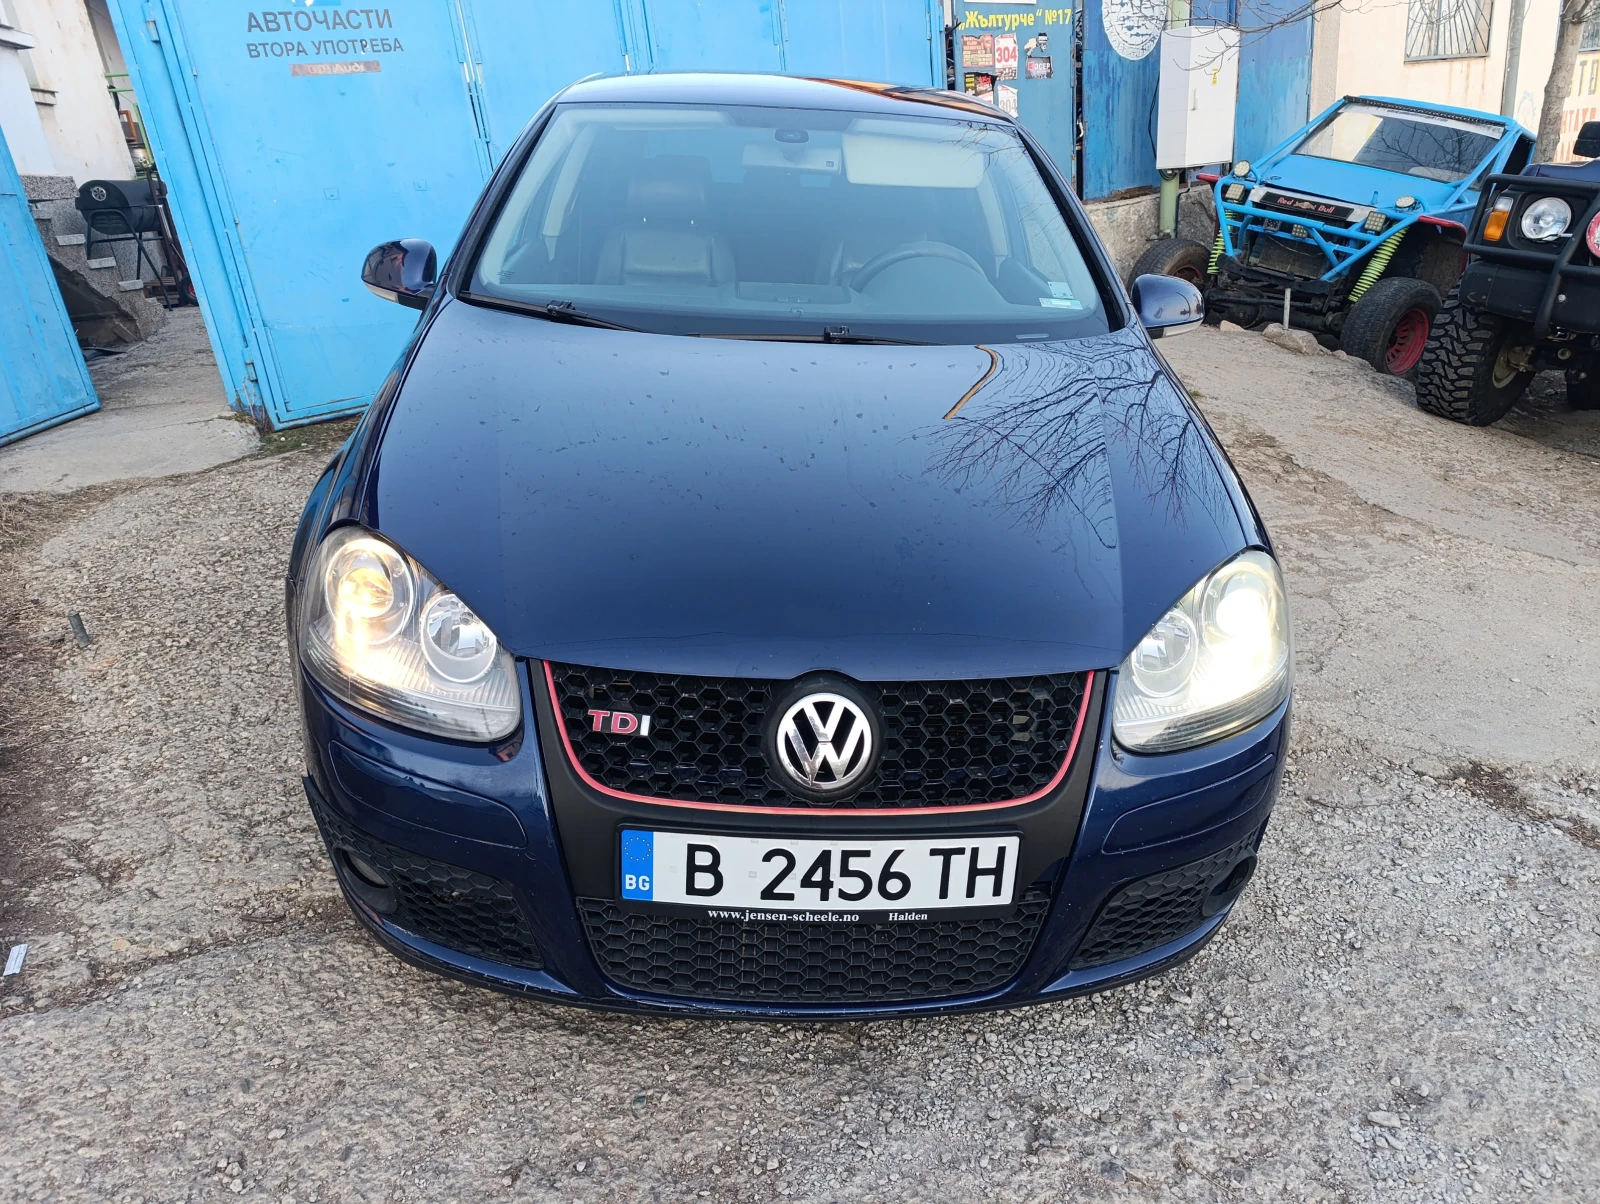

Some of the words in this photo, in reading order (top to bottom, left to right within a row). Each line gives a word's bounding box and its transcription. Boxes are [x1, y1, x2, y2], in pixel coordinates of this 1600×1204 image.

[247, 9, 393, 33] АВТОЧАСТИ
[1045, 9, 1072, 25] №17
[246, 41, 309, 58] ВТОРА
[311, 38, 404, 56] УПОТРЕБА
[996, 46, 1017, 63] 304
[332, 62, 366, 74] Audi
[999, 98, 1017, 114] 304
[1277, 197, 1294, 207] Red
[1317, 204, 1336, 214] Bull
[588, 709, 651, 737] TDI
[778, 693, 872, 790] VW
[685, 843, 724, 897] B
[760, 848, 912, 901] 2456
[929, 845, 1007, 900] TH
[625, 874, 650, 891] BG
[707, 909, 860, 922] www.jensen-scheele.no
[888, 912, 928, 922] Halden
